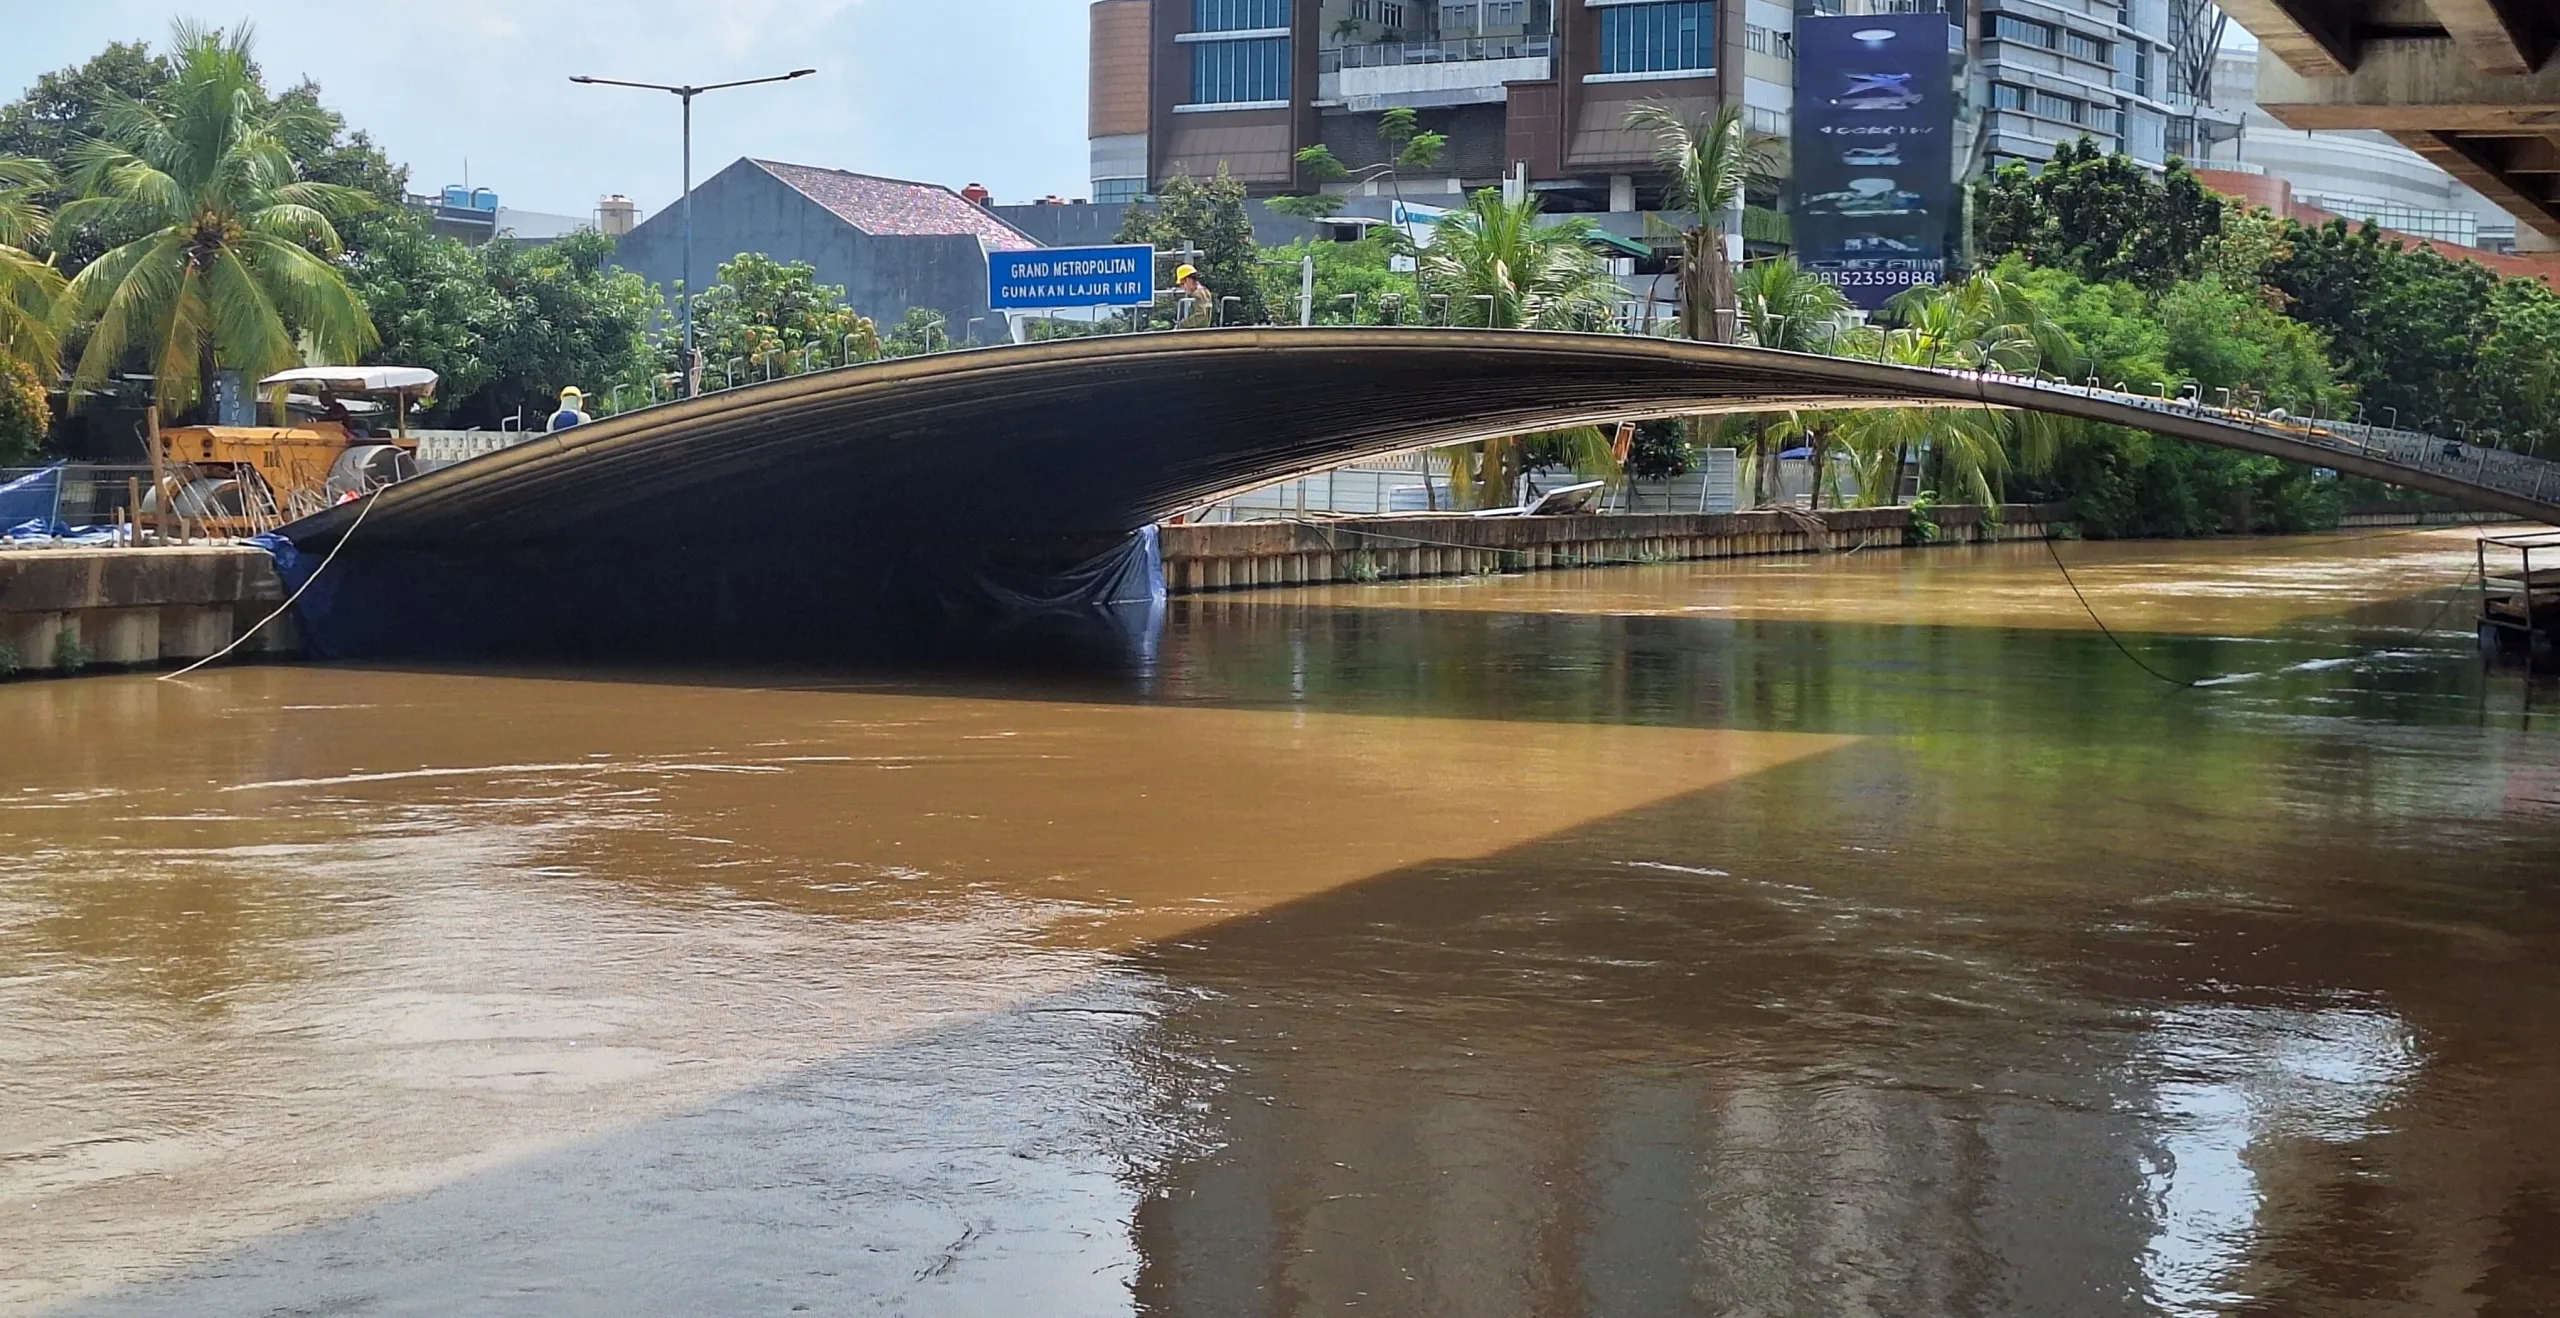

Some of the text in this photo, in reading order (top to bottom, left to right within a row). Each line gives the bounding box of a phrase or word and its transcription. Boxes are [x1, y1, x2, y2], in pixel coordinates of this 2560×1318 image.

[1011, 258, 1135, 279] GRAND METROPOLITAN
[1001, 282, 1141, 298] GUNAKAN LAJUR KIRI
